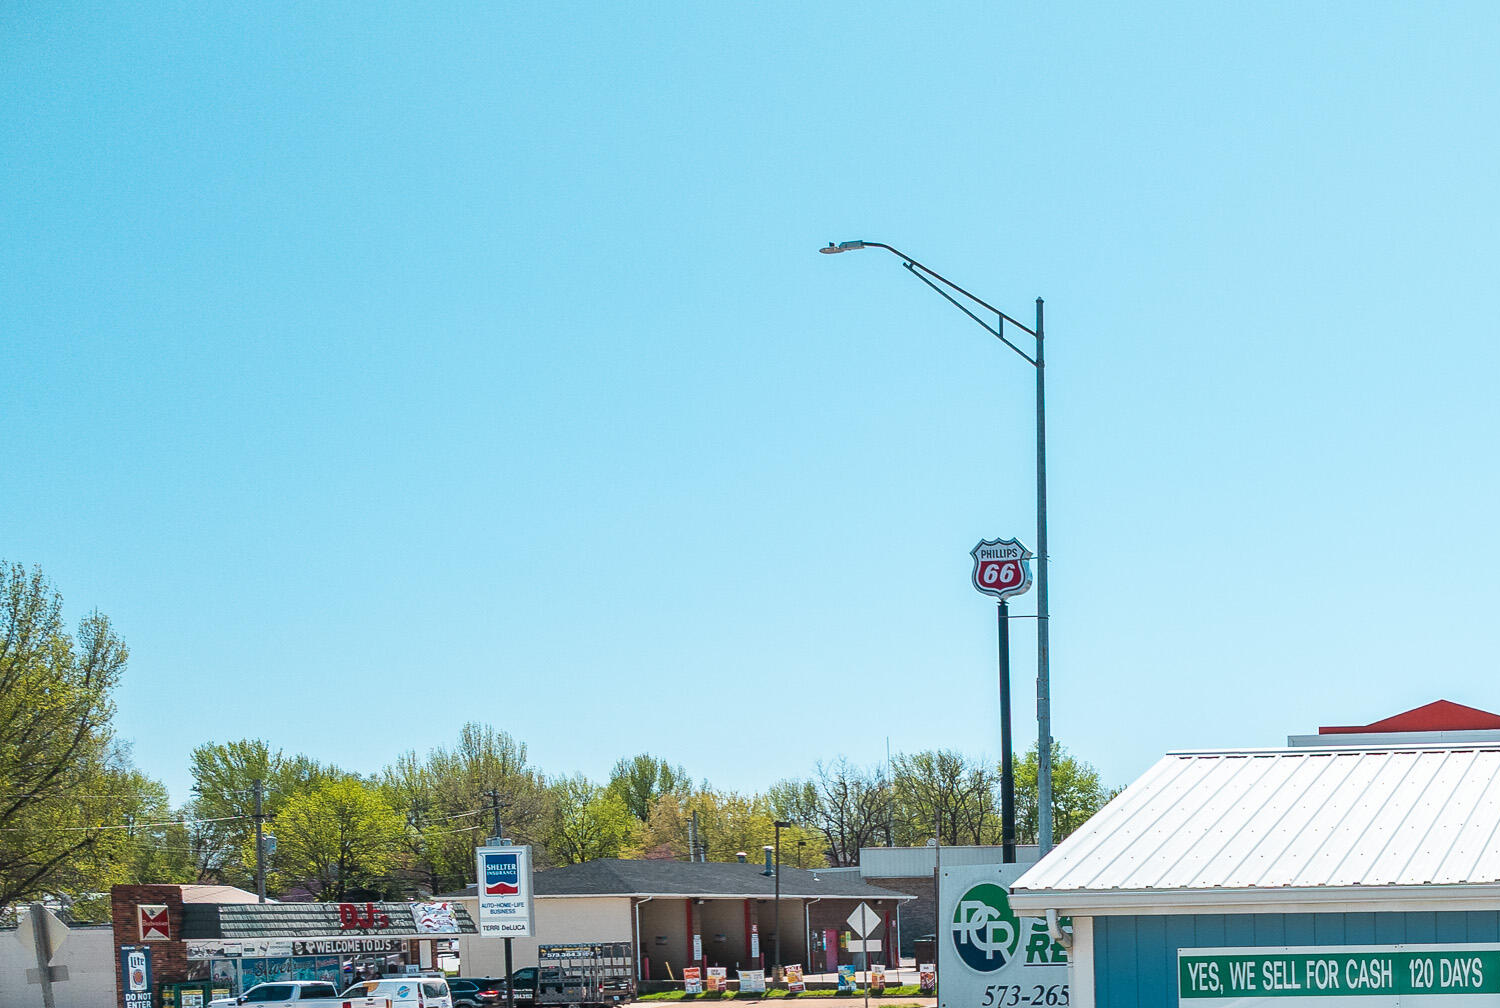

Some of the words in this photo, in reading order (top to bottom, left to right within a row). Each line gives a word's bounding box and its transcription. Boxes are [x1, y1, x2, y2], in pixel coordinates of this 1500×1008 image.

[980, 548, 1018, 559] PHILLIPS
[983, 563, 1016, 584] 66
[486, 863, 517, 871] SHELTER
[483, 924, 500, 932] TERRI
[316, 940, 360, 953] WELCOME
[361, 940, 373, 951] TO
[130, 956, 144, 969] Lite
[1187, 961, 1224, 994] YES,
[1229, 961, 1256, 990] WE
[1262, 960, 1301, 991] SELL
[1306, 959, 1340, 990] FOR
[1345, 958, 1393, 989] CASH
[1408, 957, 1434, 988] 120
[1439, 957, 1483, 988] DAYS
[125, 993, 137, 1001] DO
[137, 992, 152, 1001] NOT
